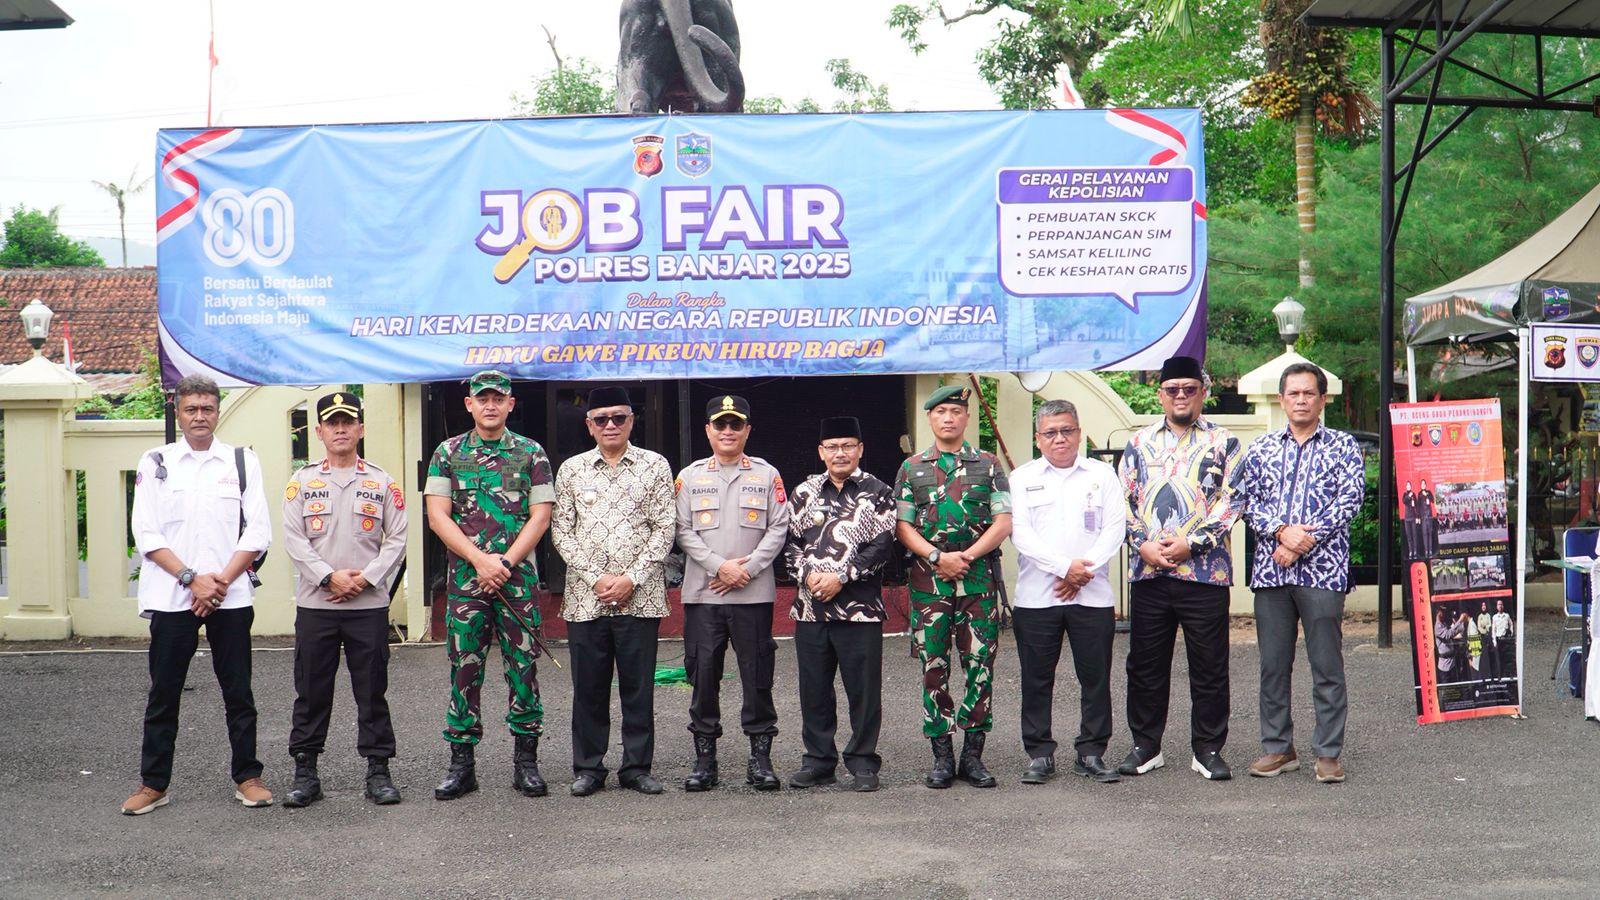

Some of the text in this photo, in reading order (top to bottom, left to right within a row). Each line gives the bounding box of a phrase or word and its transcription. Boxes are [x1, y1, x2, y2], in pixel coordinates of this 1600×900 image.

[1019, 171, 1169, 186] GERAI PELAYANAN
[1048, 185, 1144, 199] KEPOLISIAN
[475, 184, 849, 257] JOB FAIR
[1028, 211, 1157, 223] PEMBUATAN SKCK
[202, 187, 294, 267] 80
[1028, 229, 1172, 241] PERPANJANGAN SIM
[1028, 247, 1152, 259] SAMSAT KELILING
[534, 252, 851, 284] POLRES BANJAR 2025
[1028, 265, 1187, 277] CEK KESHATAN GRATIS
[203, 275, 333, 290] Bersatu Berdaulat
[204, 294, 253, 310] Rakyat
[257, 292, 326, 311] Sejahtera
[627, 291, 726, 313] Dalam Rangka
[204, 310, 310, 327] Indonesia Maju
[351, 304, 998, 337] HARI KEMERDEKAAN NEGARA REPUBLIK INDONESIA
[464, 346, 540, 365] HAYU
[542, 344, 617, 363] GAWE
[619, 342, 721, 362] PIKEUN
[718, 341, 801, 360] HIRUP
[803, 339, 886, 359] BAGJA
[304, 491, 329, 499] DANI
[356, 491, 384, 502] POLRI
[692, 487, 718, 495] RAHADI
[742, 486, 766, 494] POLRI
